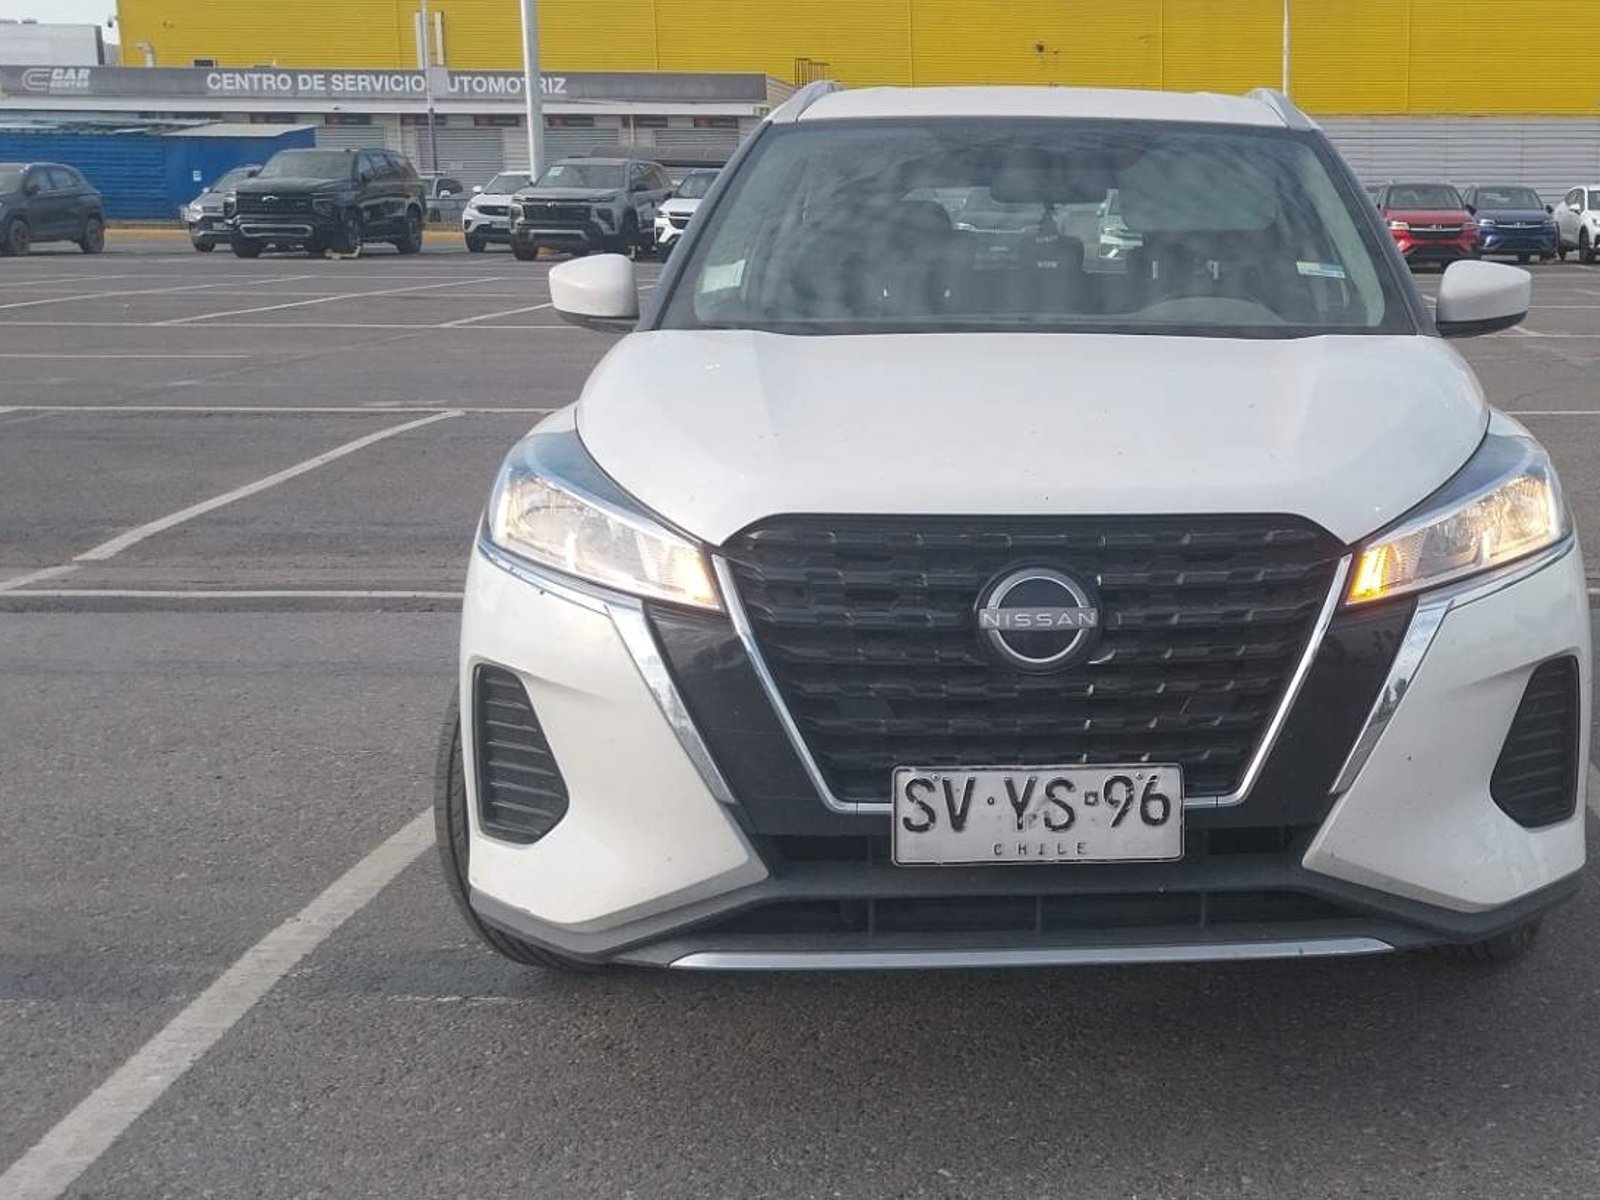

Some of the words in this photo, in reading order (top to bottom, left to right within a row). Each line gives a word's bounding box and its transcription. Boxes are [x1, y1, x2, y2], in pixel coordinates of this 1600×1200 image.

[51, 68, 91, 80] CAR
[206, 72, 292, 90] CENTRO
[298, 74, 326, 91] DE
[331, 74, 426, 92] SERVICIO
[446, 76, 568, 94] UTOMORIZ
[982, 612, 1095, 627] NISSAN
[993, 842, 1088, 856] CHILE
